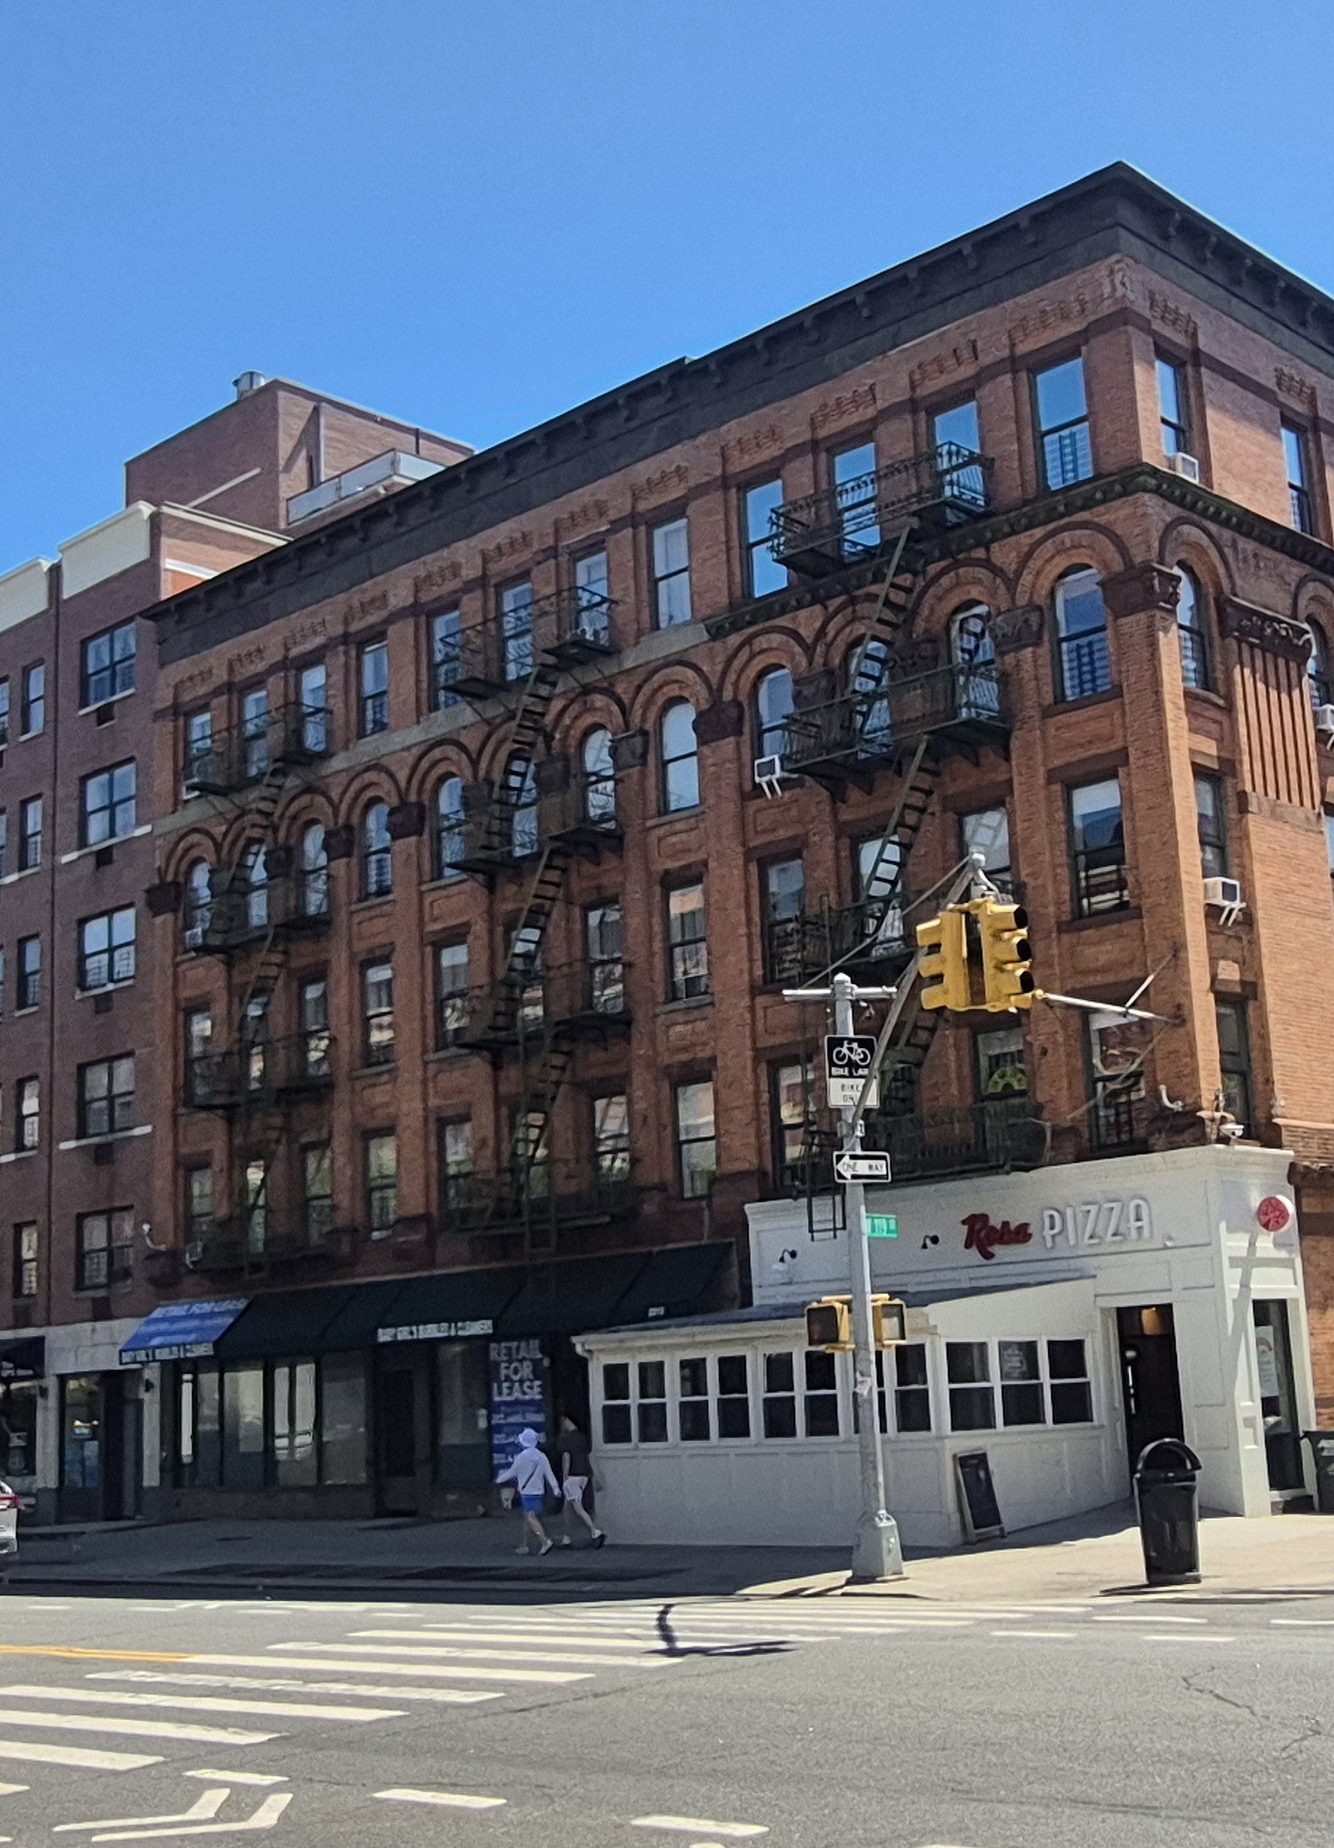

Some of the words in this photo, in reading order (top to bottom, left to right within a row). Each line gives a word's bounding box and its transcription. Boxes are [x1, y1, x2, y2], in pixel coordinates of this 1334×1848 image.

[960, 1213, 1033, 1260] Rosa
[1042, 1198, 1152, 1249] PIZZA
[489, 1339, 543, 1360] RETAIL
[500, 1360, 535, 1381] FOR
[492, 1380, 544, 1401] LEASE
